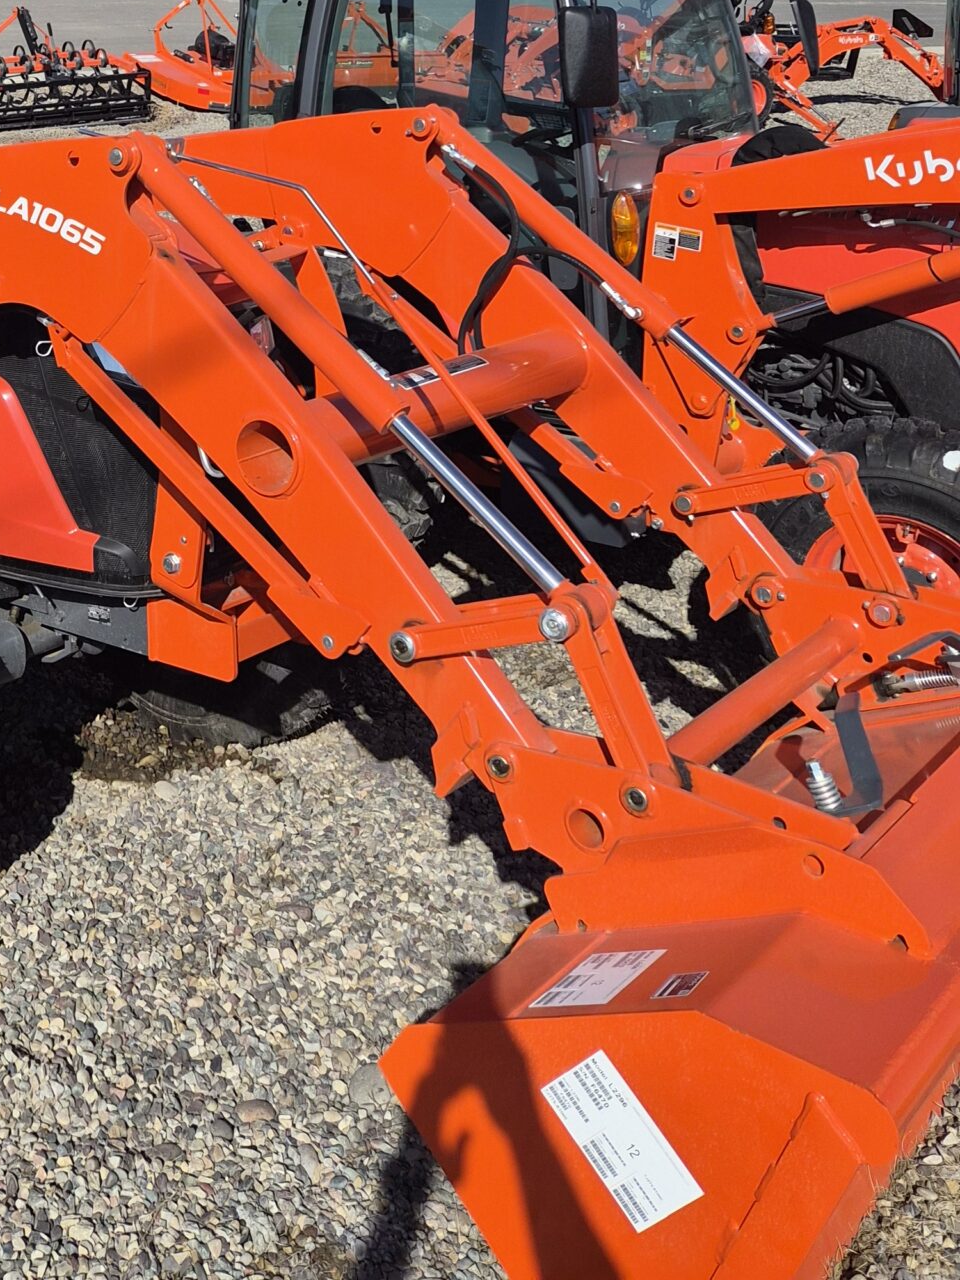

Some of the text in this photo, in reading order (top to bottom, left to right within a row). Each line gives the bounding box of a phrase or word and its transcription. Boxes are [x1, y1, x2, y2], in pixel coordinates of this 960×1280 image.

[864, 150, 960, 187] Kub
[607, 1082, 628, 1108] L2296
[624, 1142, 641, 1159] 12
